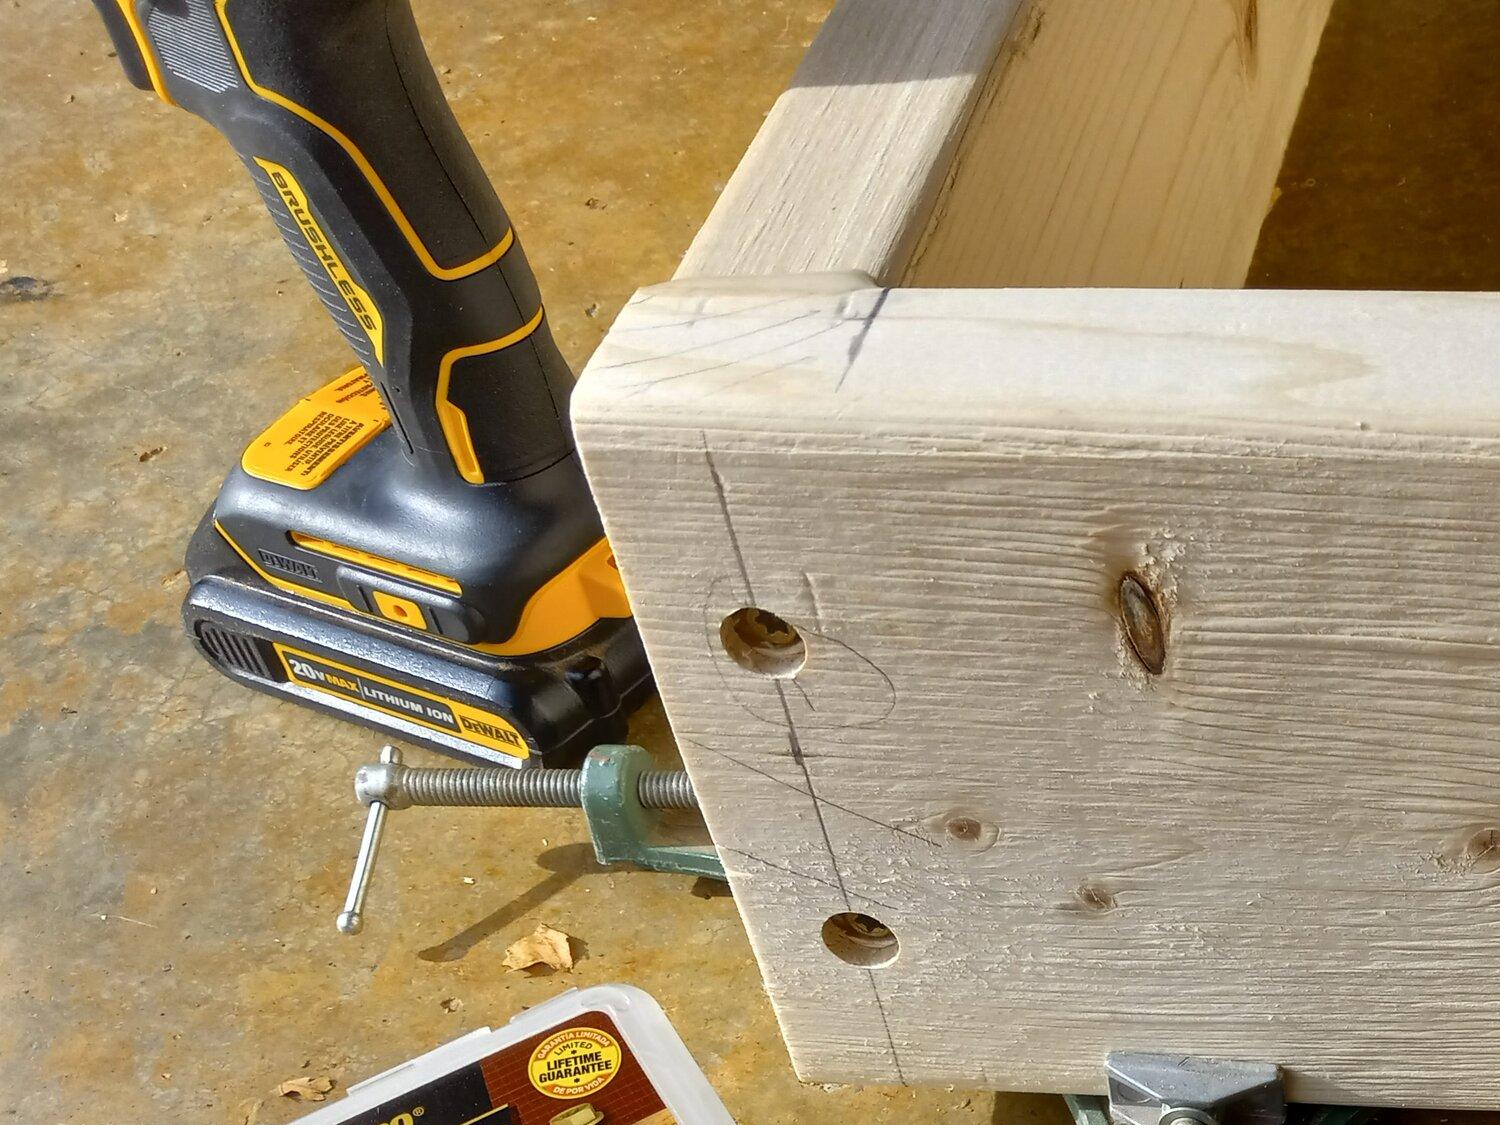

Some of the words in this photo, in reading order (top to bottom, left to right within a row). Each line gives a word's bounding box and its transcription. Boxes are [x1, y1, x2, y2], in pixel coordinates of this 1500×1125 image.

[272, 172, 376, 330] BRUSHLESS
[364, 686, 424, 714] LITHIUM
[426, 708, 454, 724] ION
[554, 1042, 592, 1056] LIMITED
[576, 1032, 610, 1047] LIMITADA
[546, 1051, 602, 1071] LIFETIME
[539, 1060, 612, 1084] GUARANTEE
[553, 1086, 566, 1094] DE
[566, 1086, 584, 1095] POR
[585, 1078, 606, 1091] VIDA
